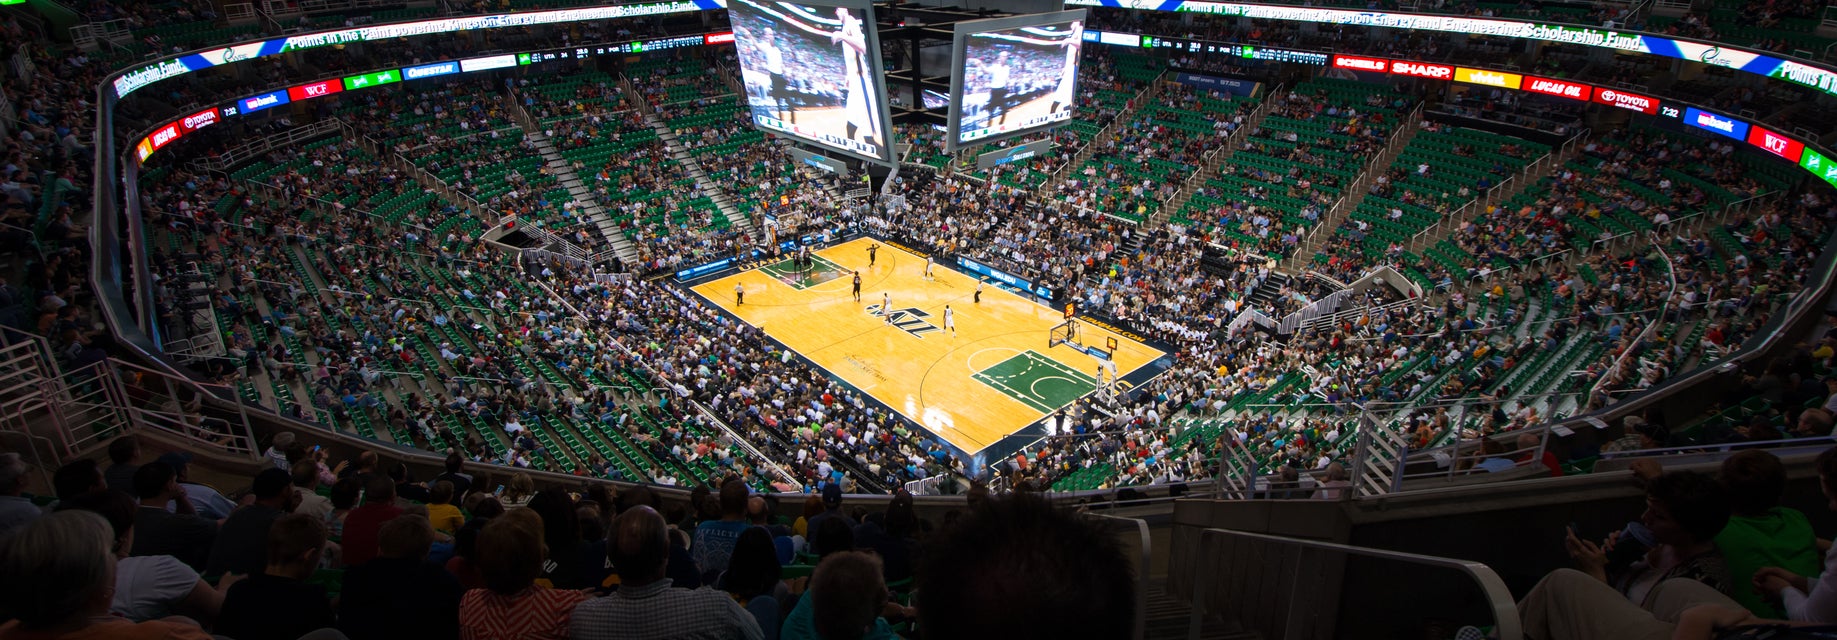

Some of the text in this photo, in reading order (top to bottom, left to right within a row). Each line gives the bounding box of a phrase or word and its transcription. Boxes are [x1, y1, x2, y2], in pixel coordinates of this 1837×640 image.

[289, 0, 695, 49] Points in the Paint powering Kingston Energy and Engineering Scholarship Fund
[1183, 2, 1641, 50] Points in the Paint powering Kingston Energy and Engineering Scholarship Fund
[408, 64, 454, 78] QUESTAR
[1336, 57, 1386, 71] SCHEELS
[1392, 62, 1450, 77] SHARP
[122, 58, 181, 90] Scholarship Fund
[1780, 62, 1819, 87] Points
[1818, 73, 1831, 90] in
[304, 84, 328, 97] WCF
[1531, 80, 1582, 97] LUCAS OIL
[1615, 94, 1650, 108] TOYOTA
[193, 111, 216, 125] TOYOTA
[223, 107, 237, 117] 7:32
[1662, 107, 1679, 117] 7:32
[1765, 134, 1788, 153] WCF
[990, 269, 1016, 285] WGU.EDU
